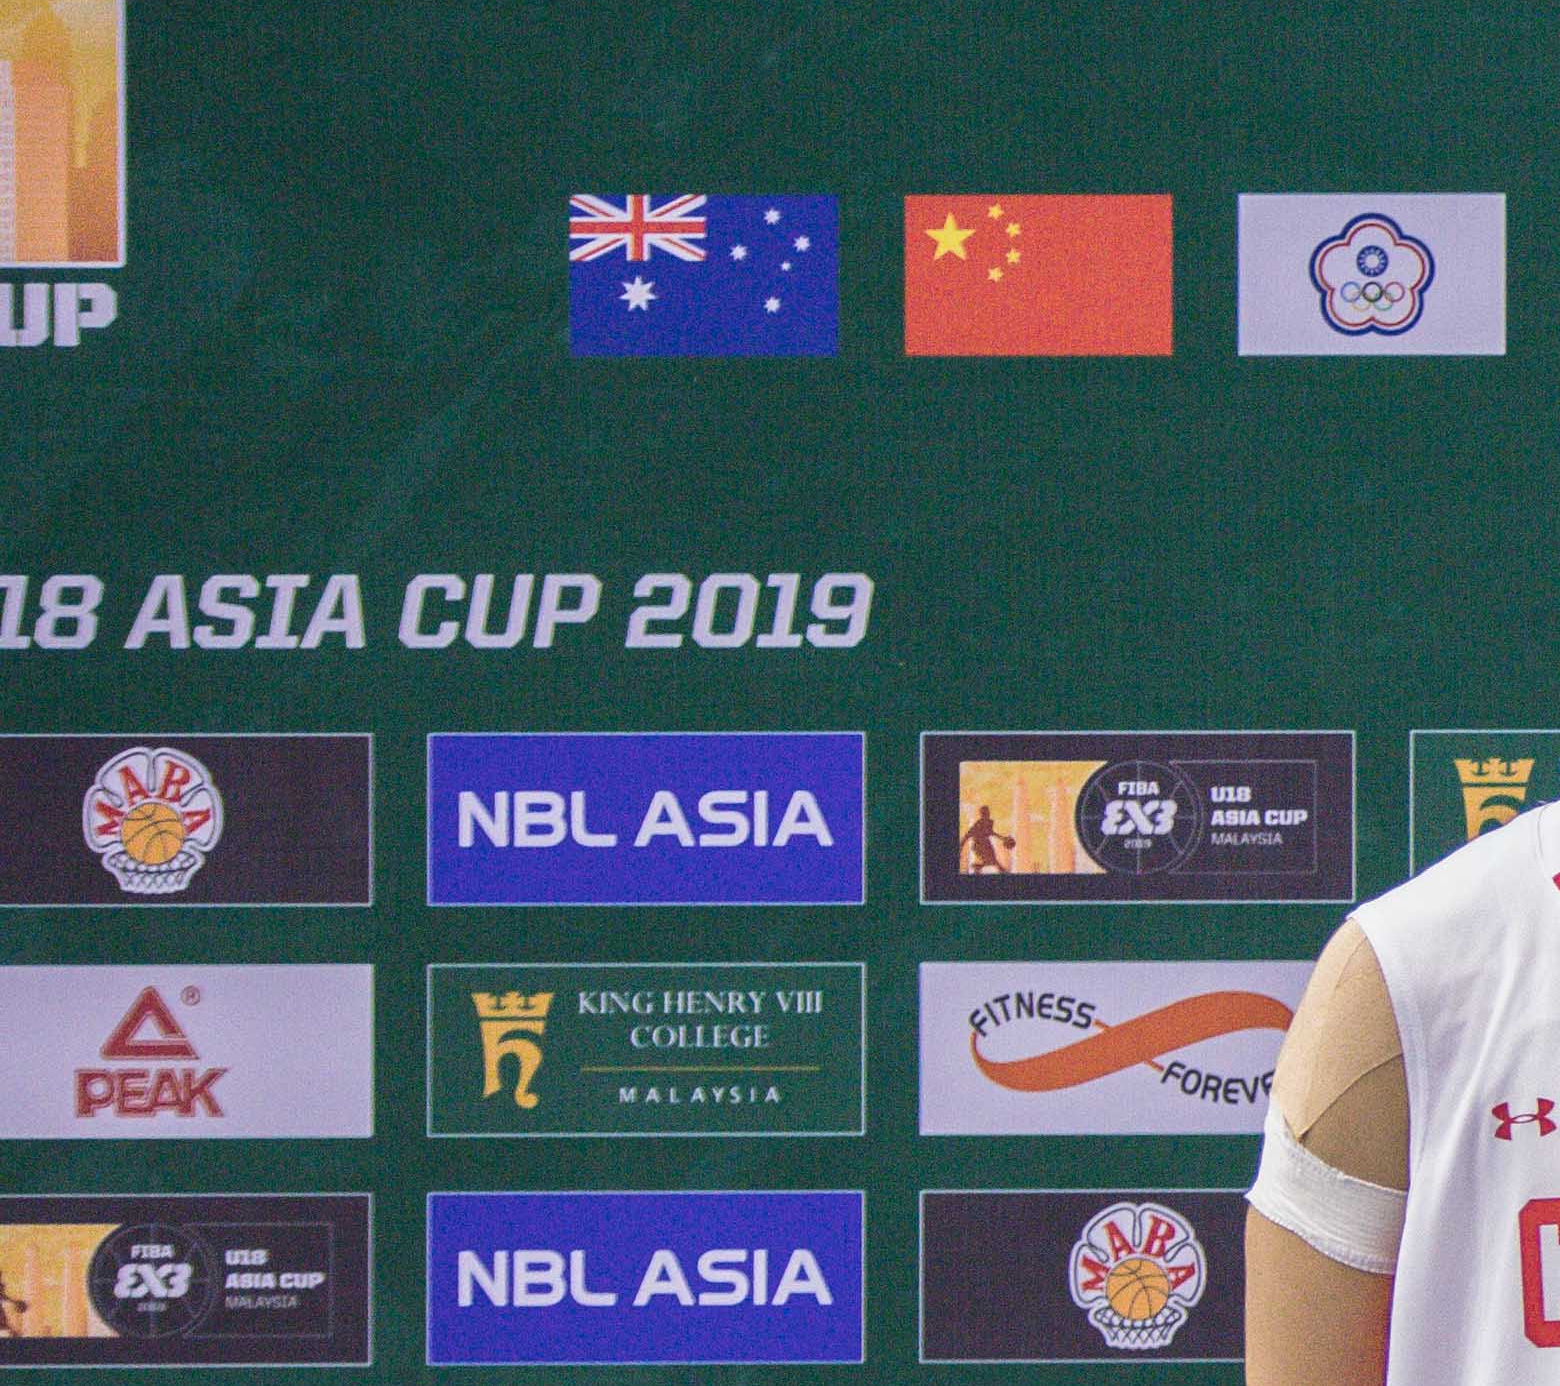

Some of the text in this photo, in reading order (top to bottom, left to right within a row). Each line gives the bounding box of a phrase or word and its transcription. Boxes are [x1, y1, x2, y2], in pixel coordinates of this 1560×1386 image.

[124, 574, 365, 648] ASIA
[399, 574, 602, 648] CUP
[625, 573, 874, 648] 2019
[96, 763, 211, 842] MABA
[1118, 781, 1159, 796] FIBA
[1211, 786, 1251, 802] U18
[459, 790, 833, 847] NBL ASIA
[1212, 810, 1308, 825] ASIA CUP
[579, 990, 823, 1014] KING HENRY VIII
[968, 991, 1098, 1040] FITNESS
[631, 1024, 768, 1048] COLLEGE
[77, 1069, 227, 1117] PEAK
[619, 1086, 781, 1104] MALAYSIA
[1082, 1218, 1195, 1297] MABA
